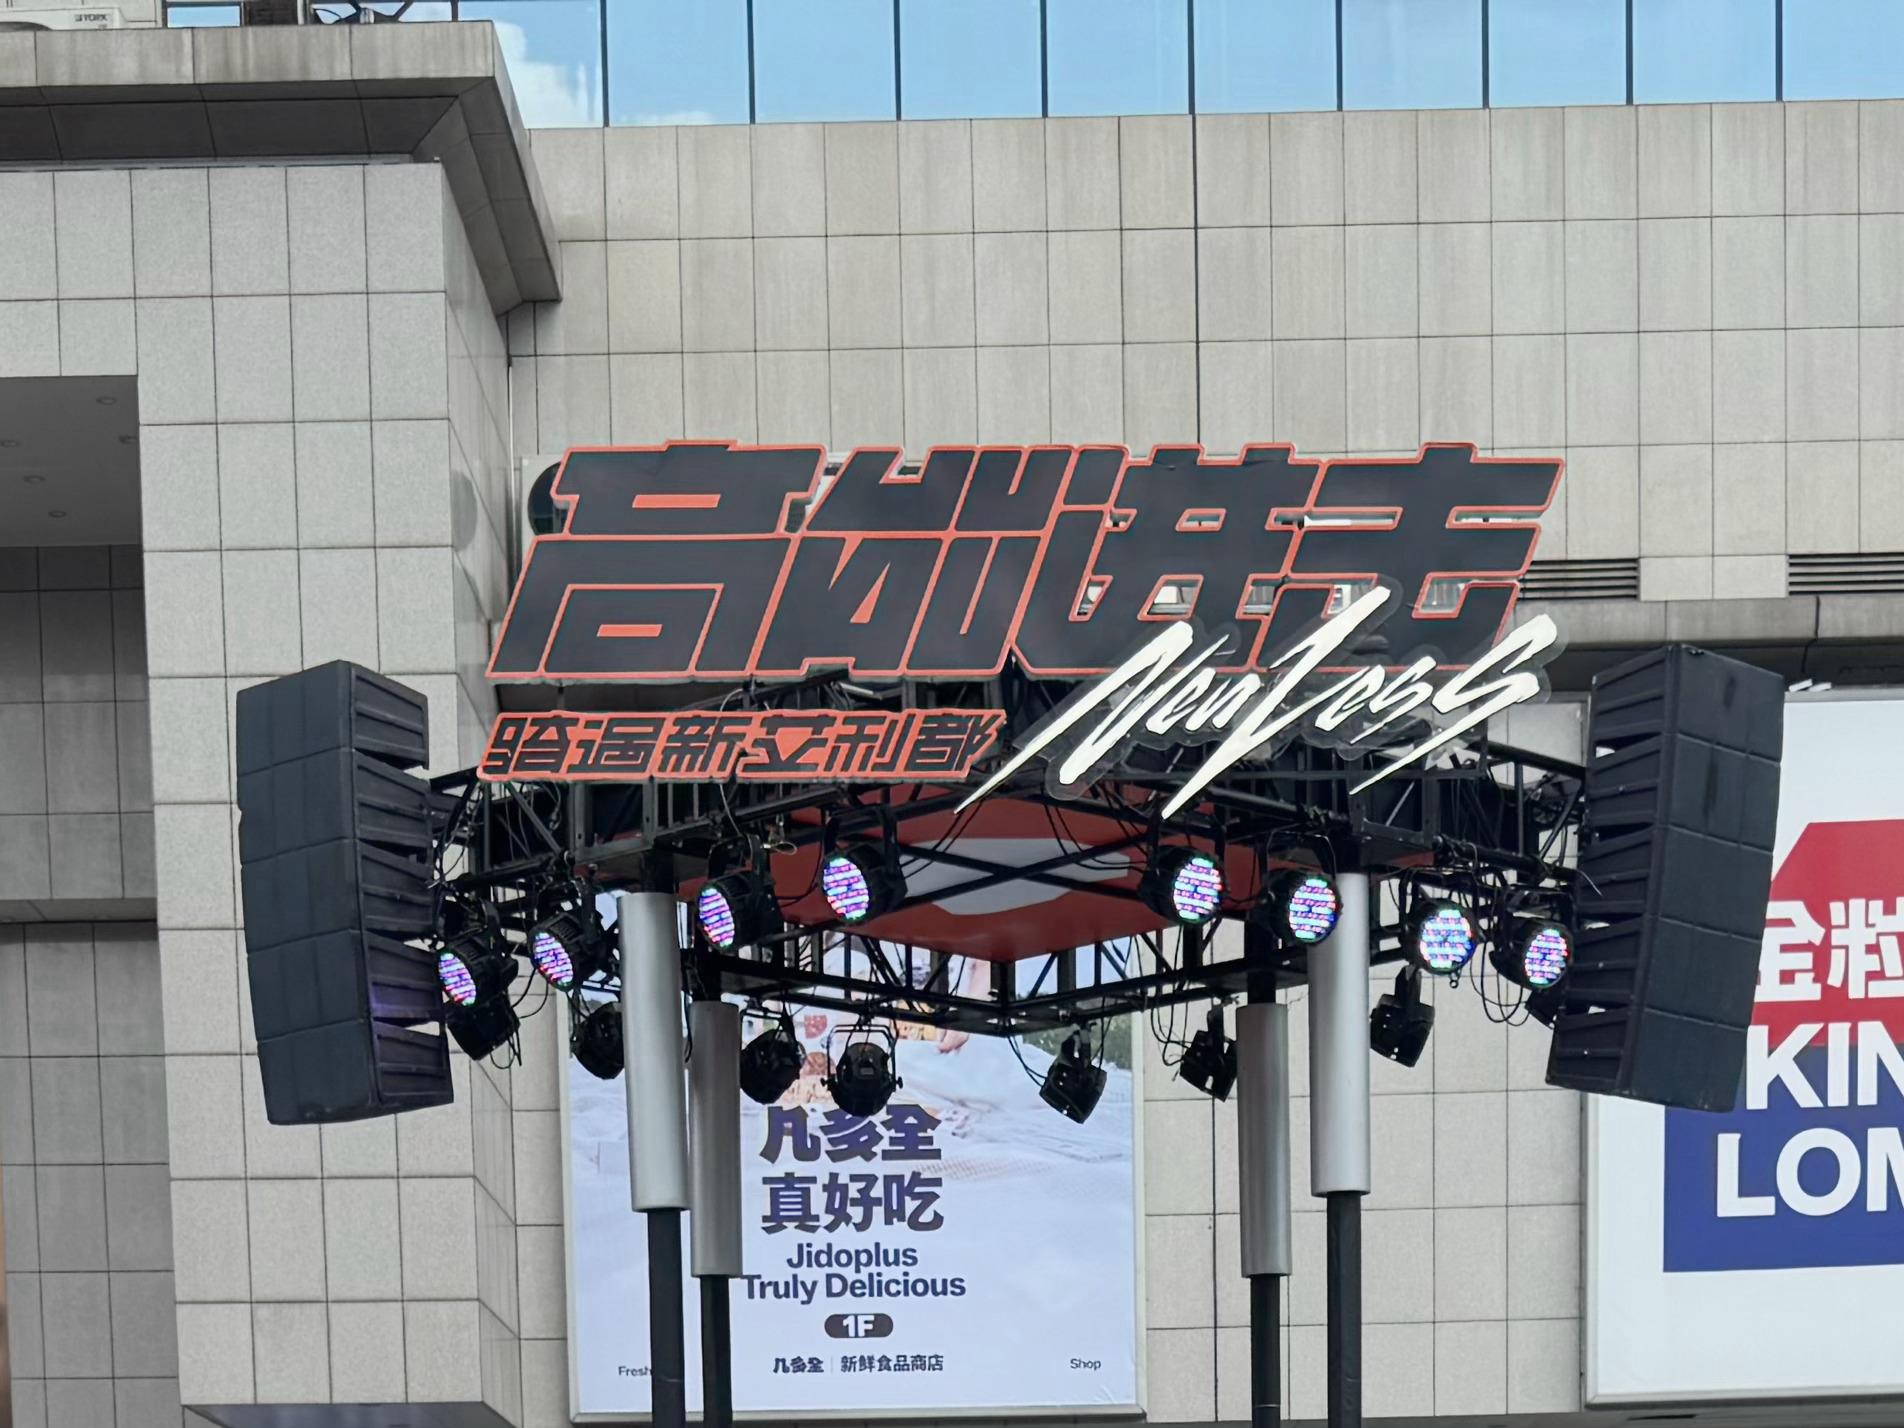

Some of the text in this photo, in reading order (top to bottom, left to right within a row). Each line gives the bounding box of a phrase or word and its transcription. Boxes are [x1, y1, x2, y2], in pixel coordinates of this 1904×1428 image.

[759, 1103, 942, 1163] 几多全
[760, 1172, 945, 1233] 真好吃
[786, 1241, 919, 1270] Jidoplus
[743, 1272, 967, 1305] Truly Delicious
[842, 1316, 874, 1339] 1F
[773, 1354, 945, 1374] 几多全 新鲜食品商店
[1069, 1357, 1102, 1372] Shop
